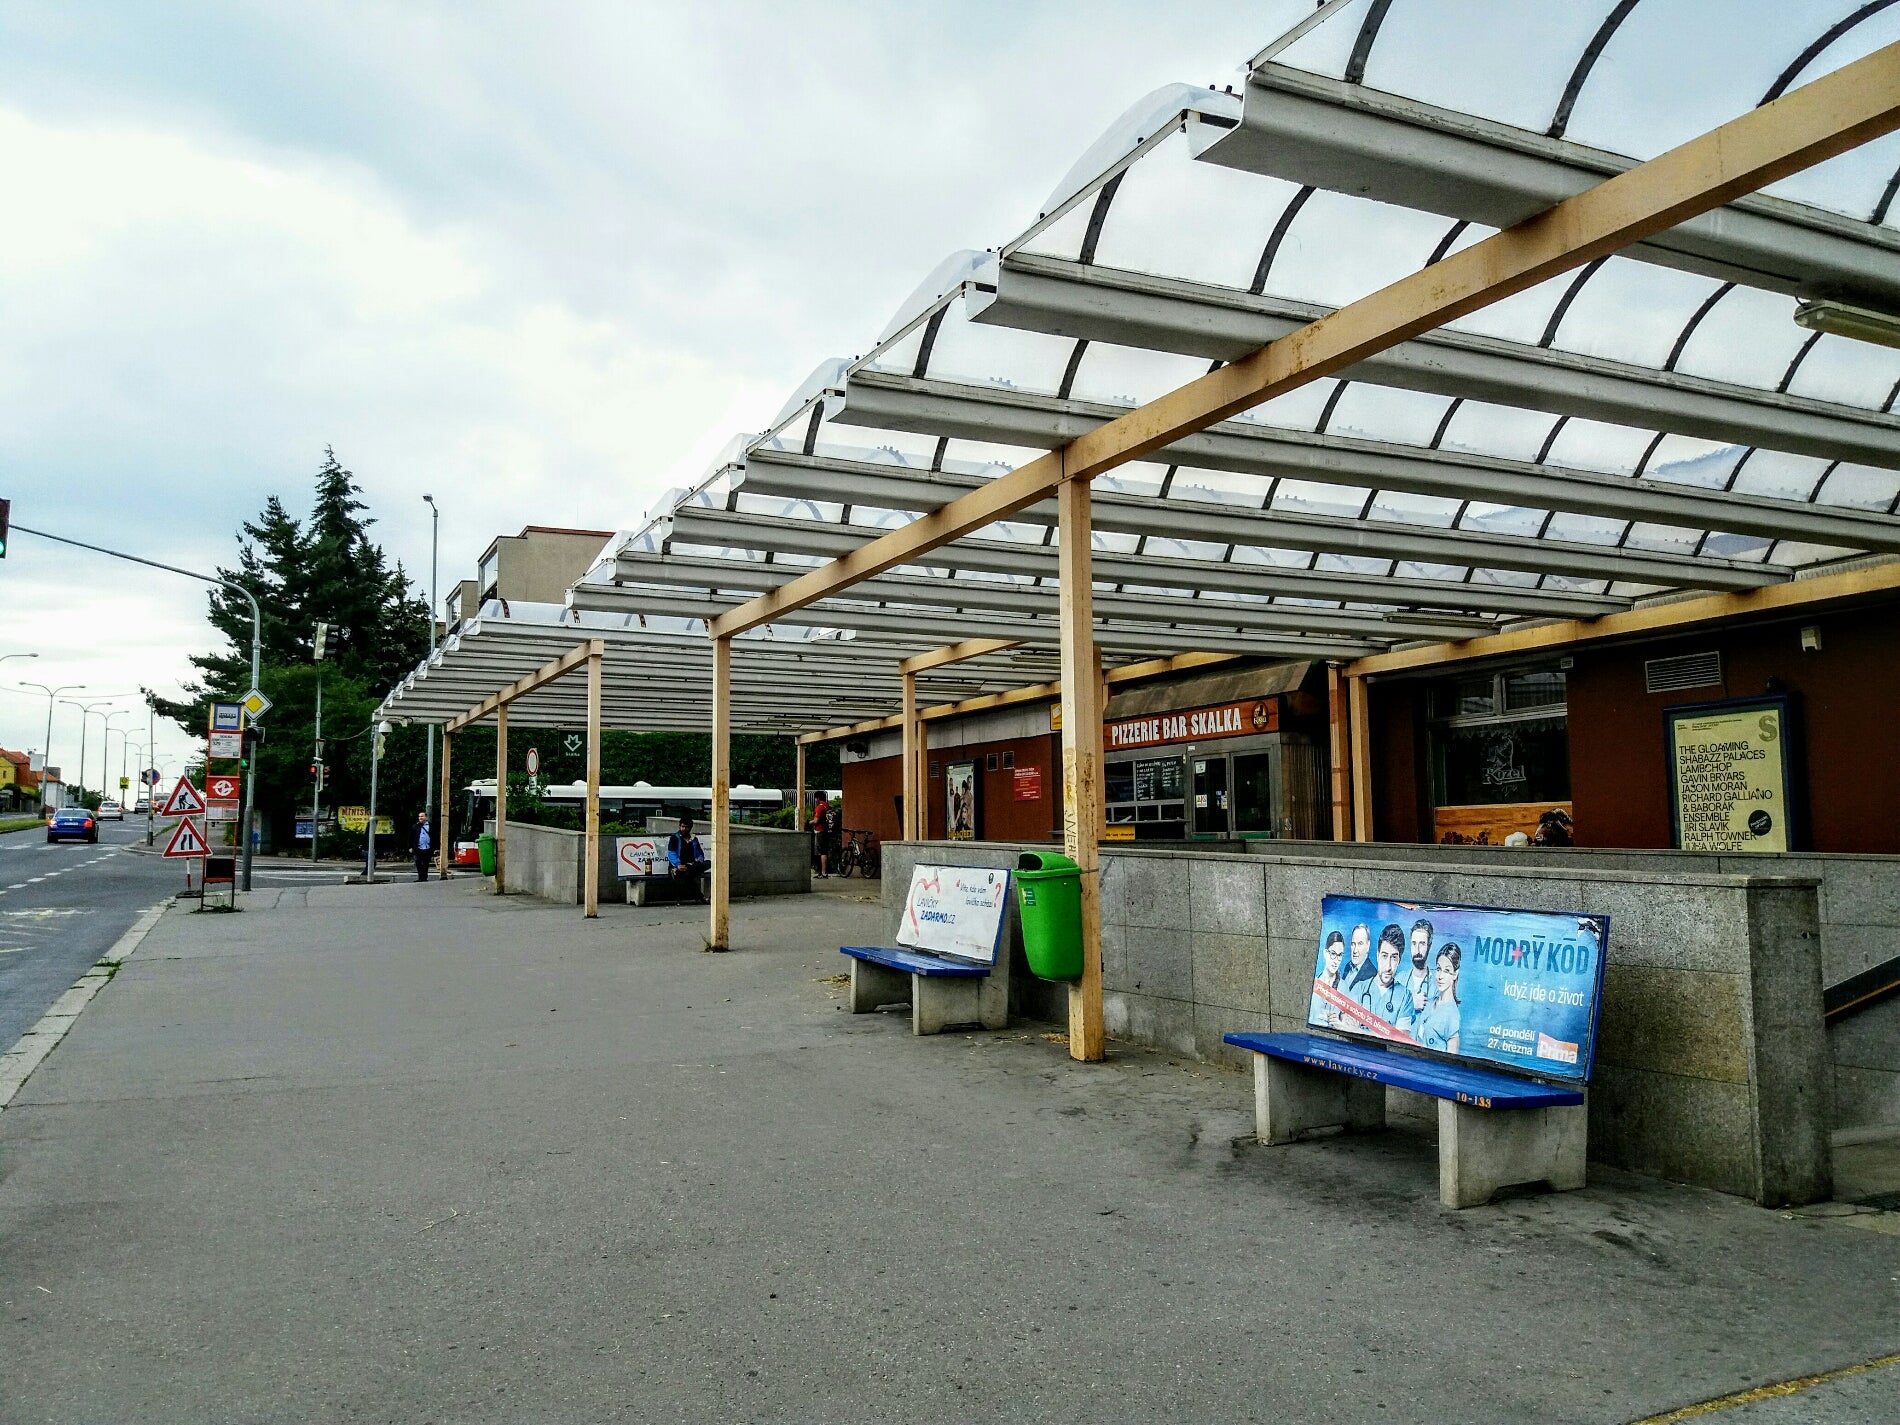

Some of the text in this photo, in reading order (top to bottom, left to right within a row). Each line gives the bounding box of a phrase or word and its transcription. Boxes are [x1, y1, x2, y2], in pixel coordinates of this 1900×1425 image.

[1111, 707, 1243, 746] PIZZERIE BAR SKALKA
[1759, 715, 1778, 742] S
[1679, 740, 1749, 755] THE GLOAMING
[1679, 749, 1766, 765] SHABAZZ PALACES
[1482, 765, 1527, 785] Kozel
[1680, 762, 1733, 774] LAMBCHOP
[1680, 771, 1746, 784] GAVIN BRYARS
[1681, 781, 1748, 794] JASON MORAN
[1681, 791, 1722, 803] RICHARD
[1682, 803, 1690, 813] &
[1683, 811, 1730, 823] ENSEMBLE
[1684, 830, 1758, 842] RALPH TOWNER
[1709, 841, 1743, 851] WOLFE
[1503, 980, 1585, 1006] když jde o život
[1489, 1025, 1536, 1042] od pondělí
[1487, 1037, 1533, 1056] 27. března
[1302, 1055, 1379, 1080] www.lavicky.cz
